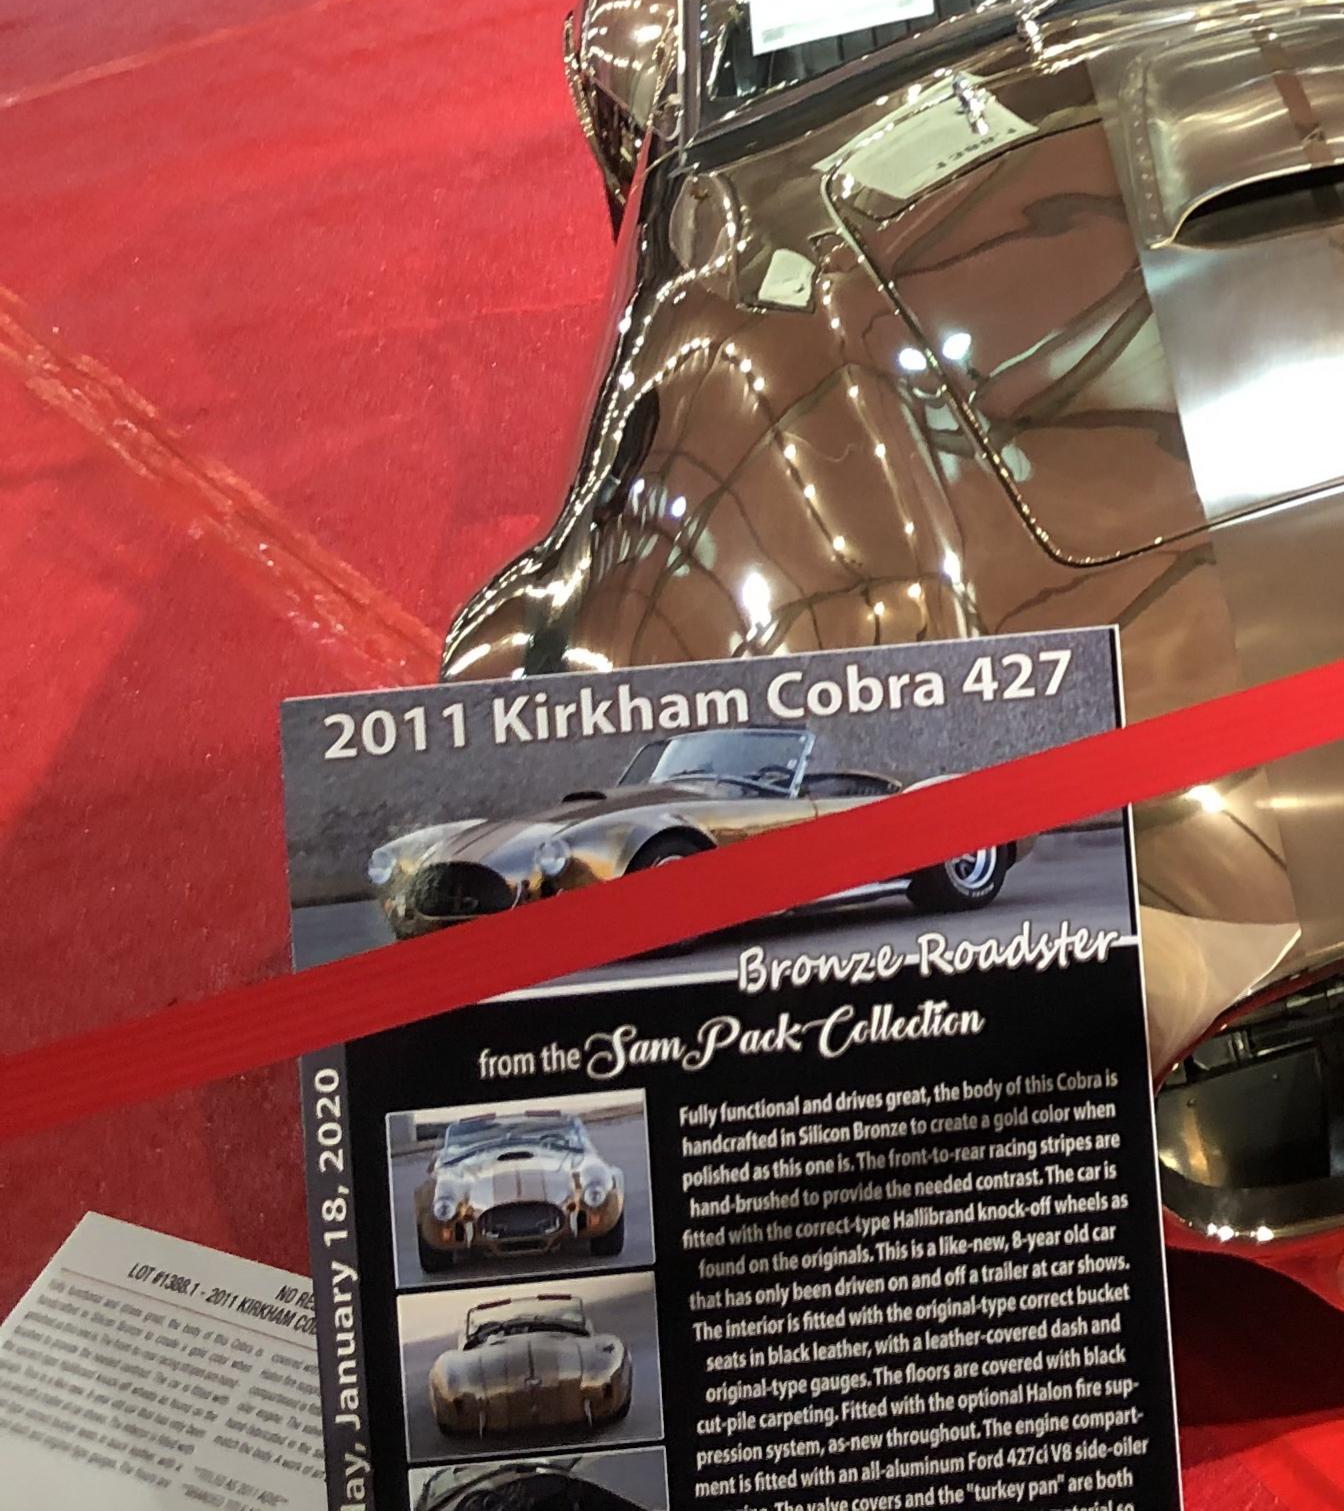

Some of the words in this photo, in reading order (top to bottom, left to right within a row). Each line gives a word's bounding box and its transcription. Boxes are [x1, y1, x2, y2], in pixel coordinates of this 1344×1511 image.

[322, 701, 469, 760] 2011
[493, 684, 750, 745] Kirkham
[766, 666, 946, 721] Cobra
[962, 649, 1074, 703] 427
[736, 945, 905, 993] Bronze
[918, 920, 1120, 978] Roadster
[477, 1051, 536, 1080] from
[539, 1045, 581, 1075] the
[583, 1024, 687, 1081] Sam
[682, 1011, 803, 1072] Pack
[803, 999, 987, 1060] Collection
[314, 1067, 346, 1175] 2020
[679, 1103, 718, 1129] Fully
[719, 1095, 800, 1123] functional
[802, 1092, 833, 1115] and
[835, 1090, 883, 1112] drives
[885, 1086, 931, 1112] great,
[933, 1082, 960, 1103] the
[962, 1077, 1003, 1102] body
[1005, 1075, 1022, 1096] of
[1024, 1074, 1054, 1094] this
[1056, 1070, 1103, 1091] Cobra
[1105, 1068, 1119, 1087] is
[681, 1128, 778, 1157] handcrafted
[780, 1127, 796, 1148] in
[798, 1124, 851, 1146] Silicon
[852, 1120, 908, 1141] Bronze
[909, 1117, 928, 1136] to
[930, 1113, 978, 1133] create
[981, 1114, 991, 1129] a
[993, 1106, 1029, 1133] gold
[1031, 1103, 1071, 1124] color
[1073, 1100, 1116, 1121] when
[682, 1161, 751, 1193] polished
[752, 1164, 771, 1182] as
[771, 1157, 803, 1179] this
[804, 1158, 835, 1176] one
[837, 1152, 855, 1173] is.
[855, 1150, 886, 1171] The
[888, 1145, 986, 1168] front-to-rear
[989, 1137, 1038, 1161] racing
[1039, 1133, 1093, 1157] stripes
[1095, 1132, 1121, 1150] are
[689, 1187, 800, 1219] hand-brushed
[802, 1189, 820, 1206] to
[822, 1181, 883, 1209] provide
[885, 1178, 912, 1199] the
[914, 1171, 973, 1197] needed
[975, 1168, 1044, 1191] contrast.
[1044, 1164, 1075, 1185] The
[1076, 1165, 1102, 1182] car
[1103, 1160, 1117, 1180] is
[321, 1184, 350, 1249] 18,
[682, 1226, 726, 1249] fitted
[728, 1223, 764, 1245] with
[766, 1221, 793, 1241] the
[795, 1215, 891, 1239] correct-type
[893, 1202, 975, 1230] Hallibrand
[977, 1195, 1052, 1222] knock-off
[1054, 1191, 1109, 1215] wheels
[1110, 1193, 1129, 1210] as
[689, 1290, 723, 1311] that
[724, 1287, 753, 1308] has
[755, 1282, 790, 1308] only
[792, 1281, 832, 1301] been
[834, 1275, 885, 1297] driven
[887, 1275, 909, 1292] on
[911, 1266, 942, 1290] and
[944, 1264, 967, 1287] off
[968, 1268, 979, 1285] a
[981, 1260, 1029, 1284] trailer
[1031, 1259, 1048, 1279] at
[1050, 1259, 1075, 1277] car
[1077, 1253, 1130, 1275] shows.
[698, 1255, 746, 1279] found
[748, 1258, 770, 1274] on
[772, 1251, 799, 1272] the
[801, 1243, 875, 1272] originals.
[874, 1240, 909, 1262] This
[910, 1238, 924, 1259] is
[926, 1241, 937, 1258] a
[938, 1235, 1010, 1256] like-new,
[1011, 1230, 1062, 1254] 8-year
[1063, 1222, 1090, 1245] old
[1092, 1225, 1117, 1242] car
[127, 1262, 156, 1283] LOT
[205, 1287, 239, 1312] 2011
[236, 1295, 298, 1328] KIRKHAM
[330, 1259, 360, 1431] January
[696, 1442, 763, 1471] pression
[765, 1439, 825, 1464] system,
[827, 1433, 884, 1454] as-new
[885, 1421, 982, 1449] throughout.
[982, 1417, 1013, 1439] The
[1014, 1412, 1070, 1439] engine
[1071, 1406, 1144, 1432] compart-
